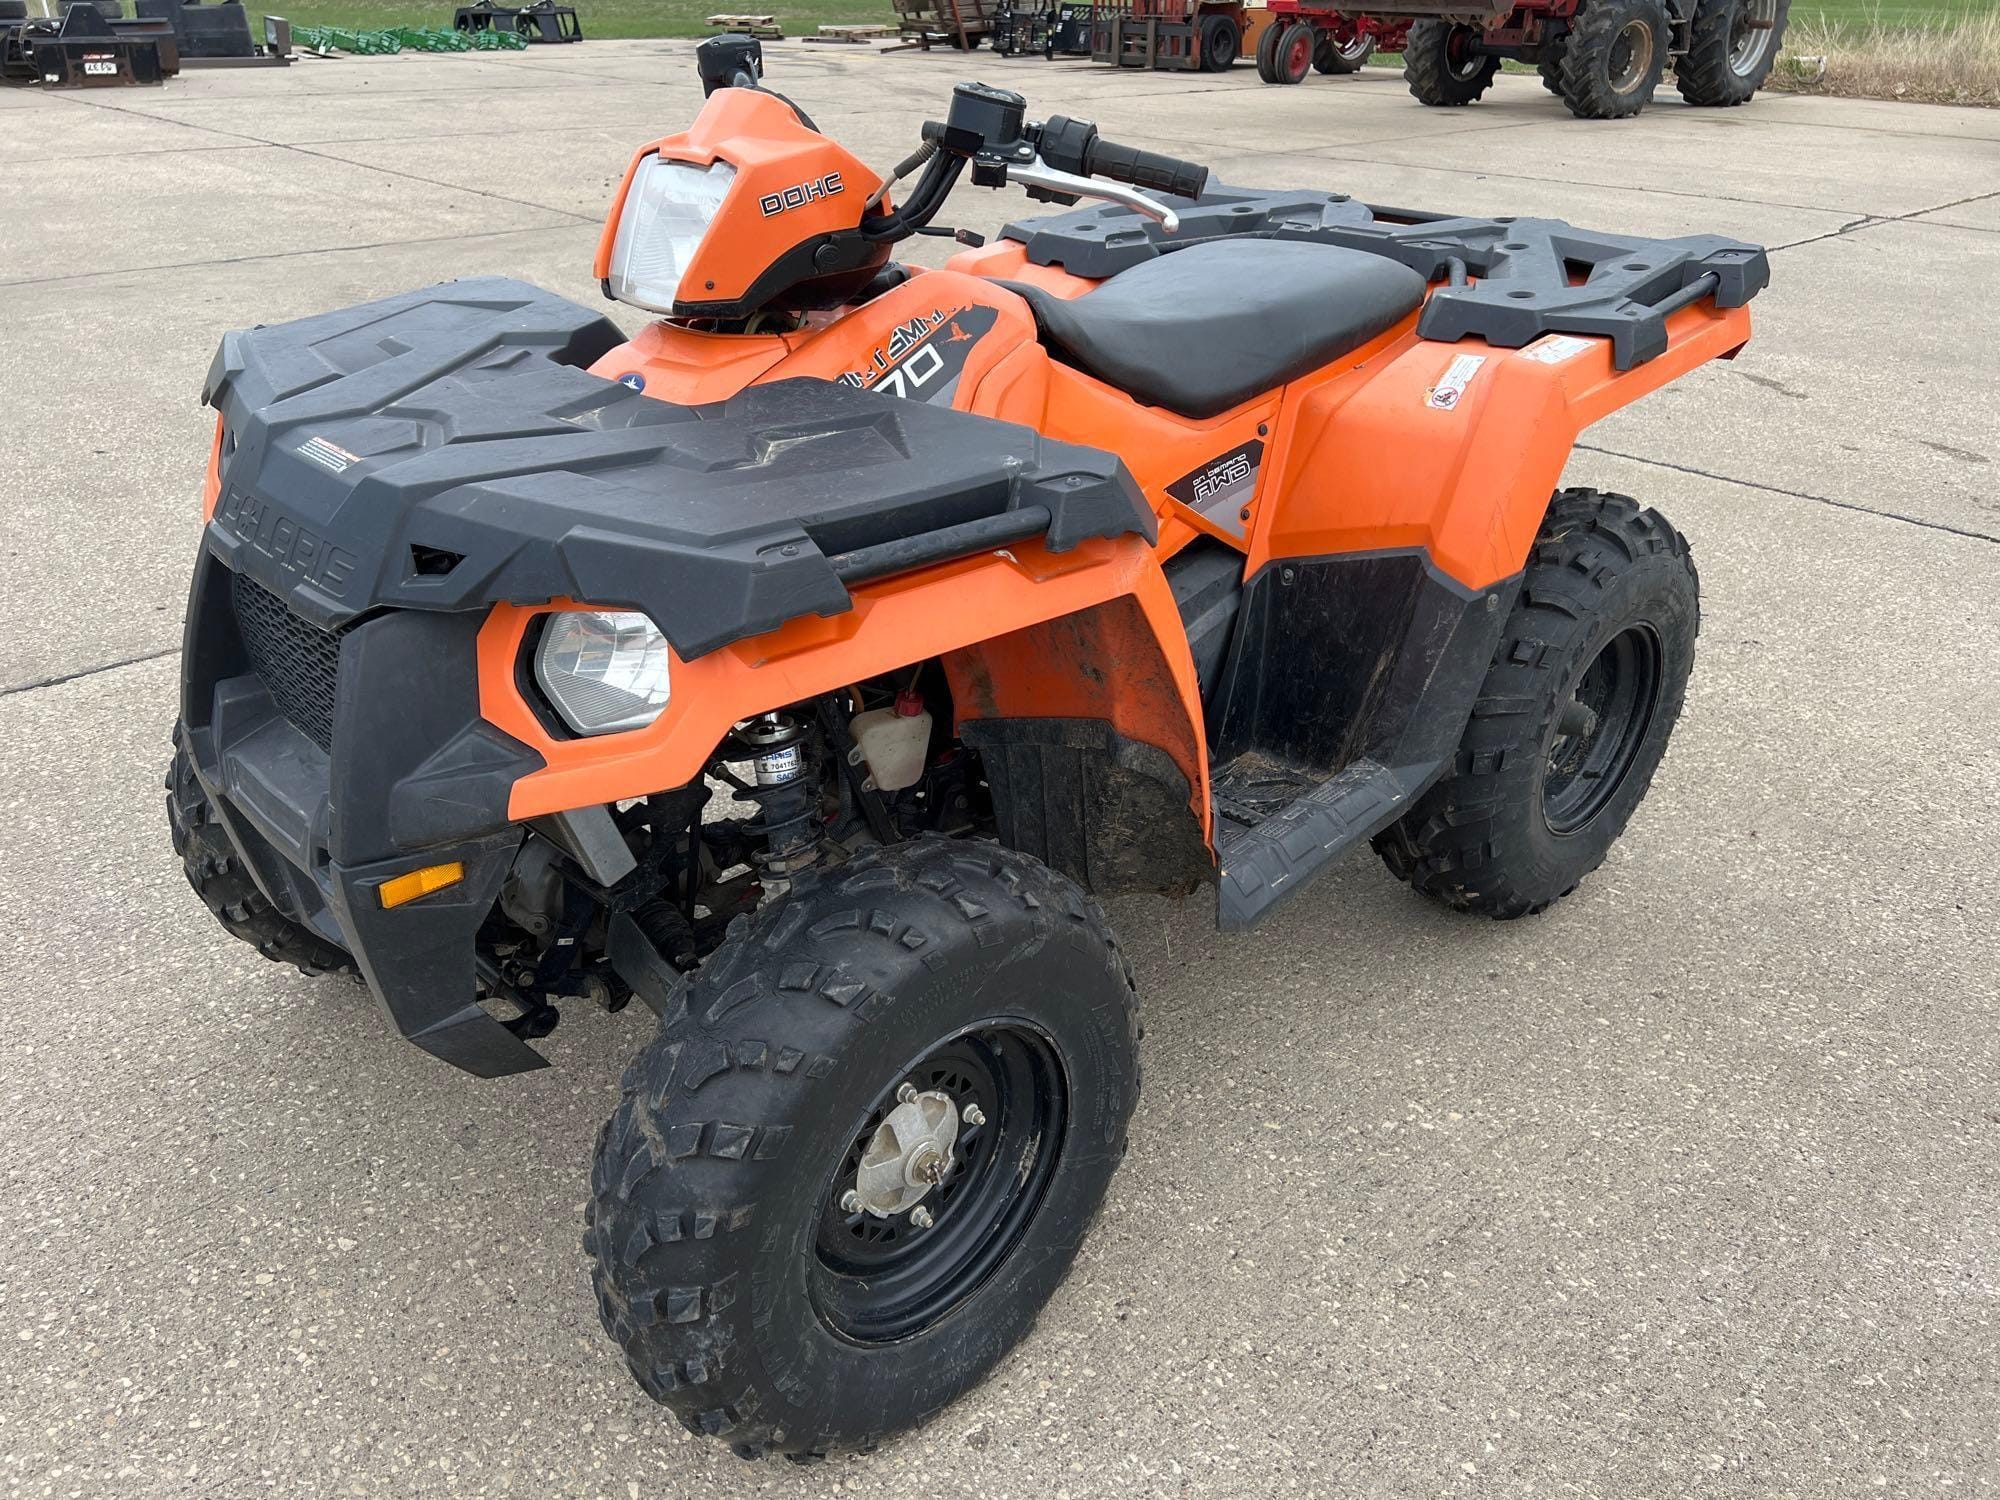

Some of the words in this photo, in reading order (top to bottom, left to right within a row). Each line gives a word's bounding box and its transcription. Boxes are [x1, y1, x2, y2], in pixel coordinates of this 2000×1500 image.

[759, 172, 844, 217] DOHC
[1194, 460, 1251, 503] AWD
[218, 483, 358, 598] POLARIS
